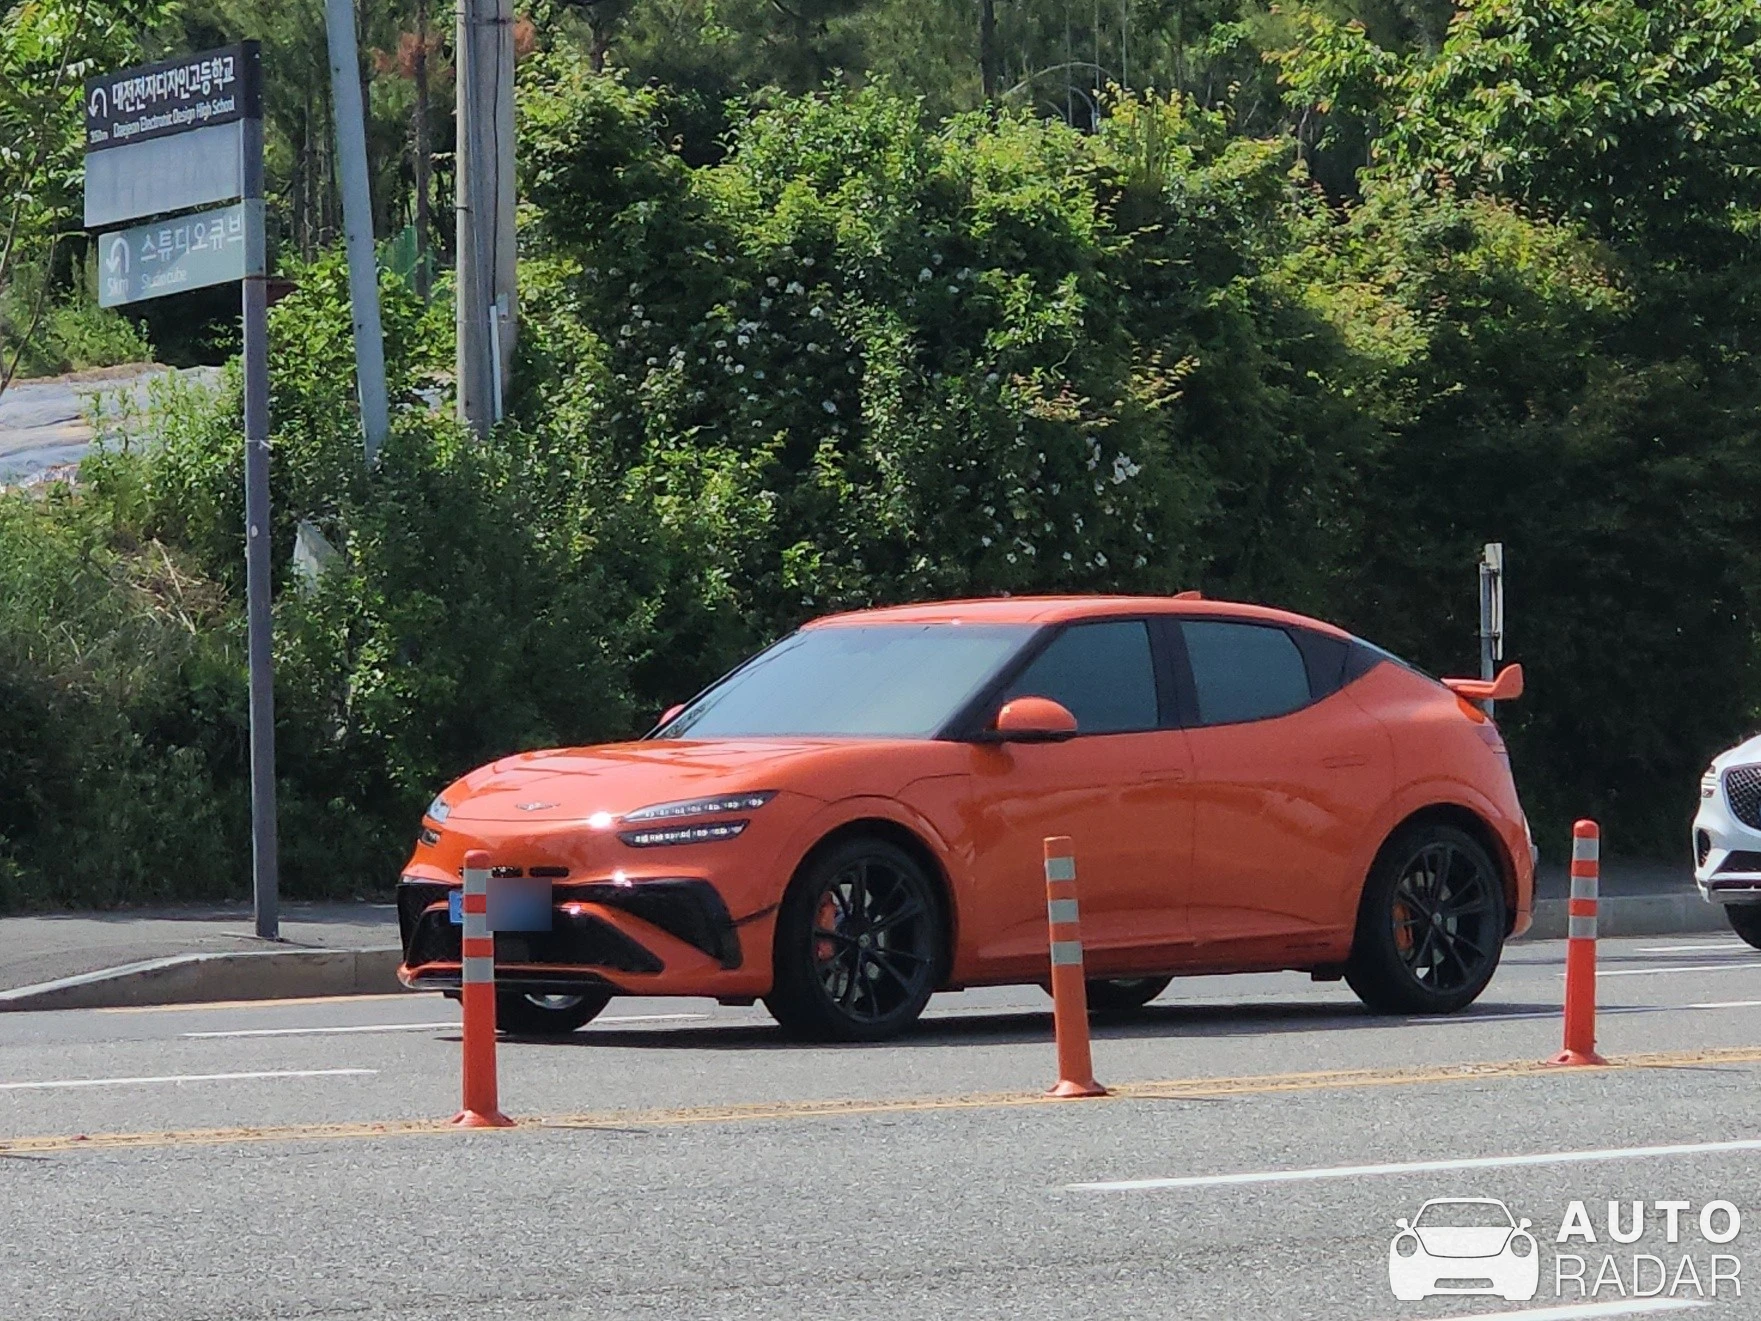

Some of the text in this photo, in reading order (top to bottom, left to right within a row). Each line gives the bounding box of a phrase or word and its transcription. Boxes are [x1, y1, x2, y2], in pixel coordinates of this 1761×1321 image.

[112, 56, 235, 113] 대전전자디자인고등학교
[140, 112, 173, 132] Electronic
[172, 106, 196, 125] Design
[195, 101, 212, 121] High
[211, 95, 235, 115] School
[140, 214, 243, 262] 스튜디오큐브
